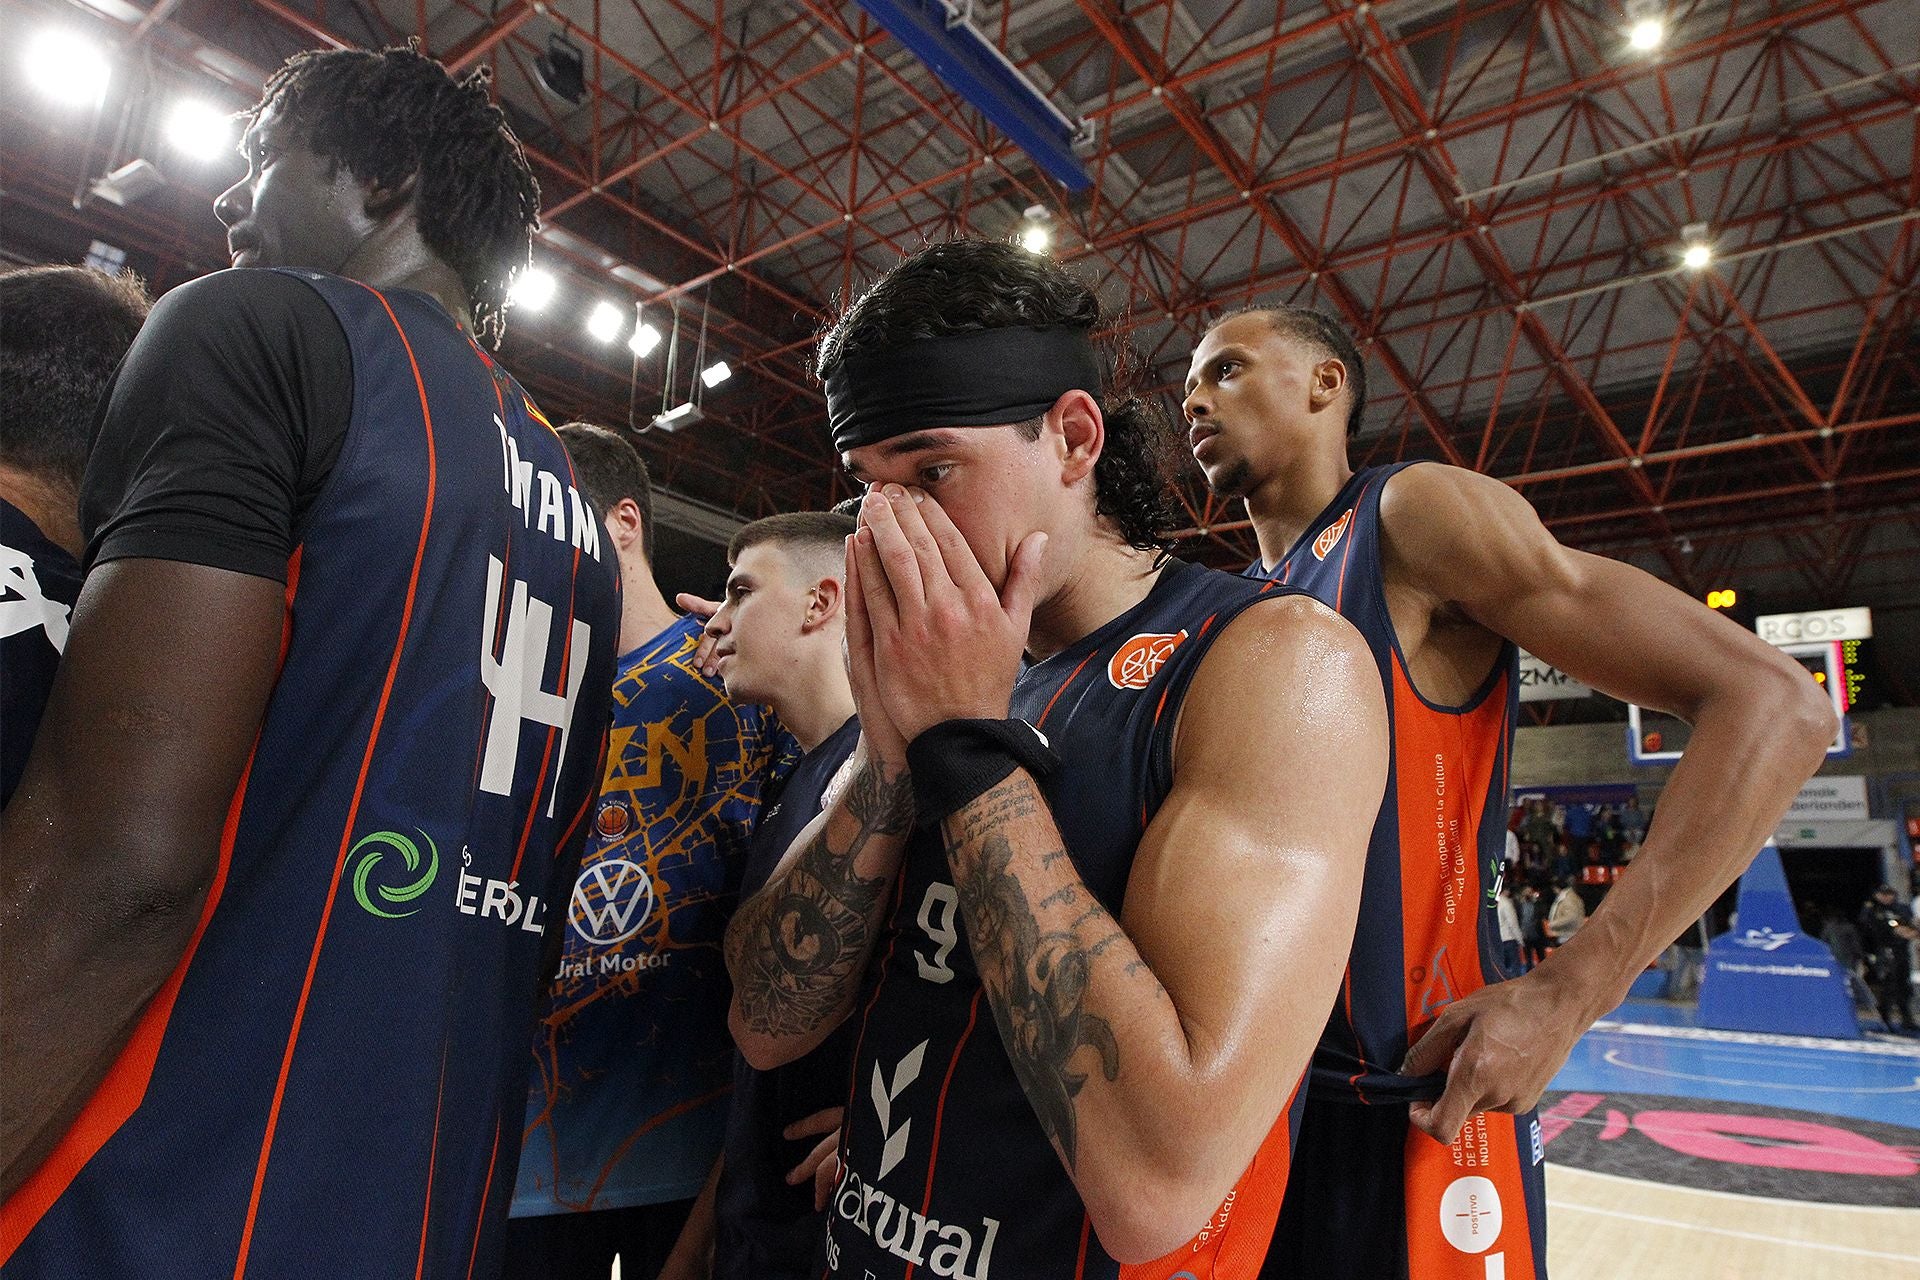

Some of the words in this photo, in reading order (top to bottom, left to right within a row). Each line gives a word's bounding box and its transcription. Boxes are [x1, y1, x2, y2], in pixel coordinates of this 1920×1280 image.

[1434, 753, 1446, 796] Cultura
[1435, 813, 1445, 829] de
[1436, 799, 1444, 811] la
[1437, 832, 1451, 880] Europea
[1442, 879, 1457, 924] Capital
[913, 881, 959, 985] 9
[600, 951, 672, 975] Motor
[1466, 1150, 1478, 1167] DE
[1469, 1193, 1479, 1235] POSITIVO
